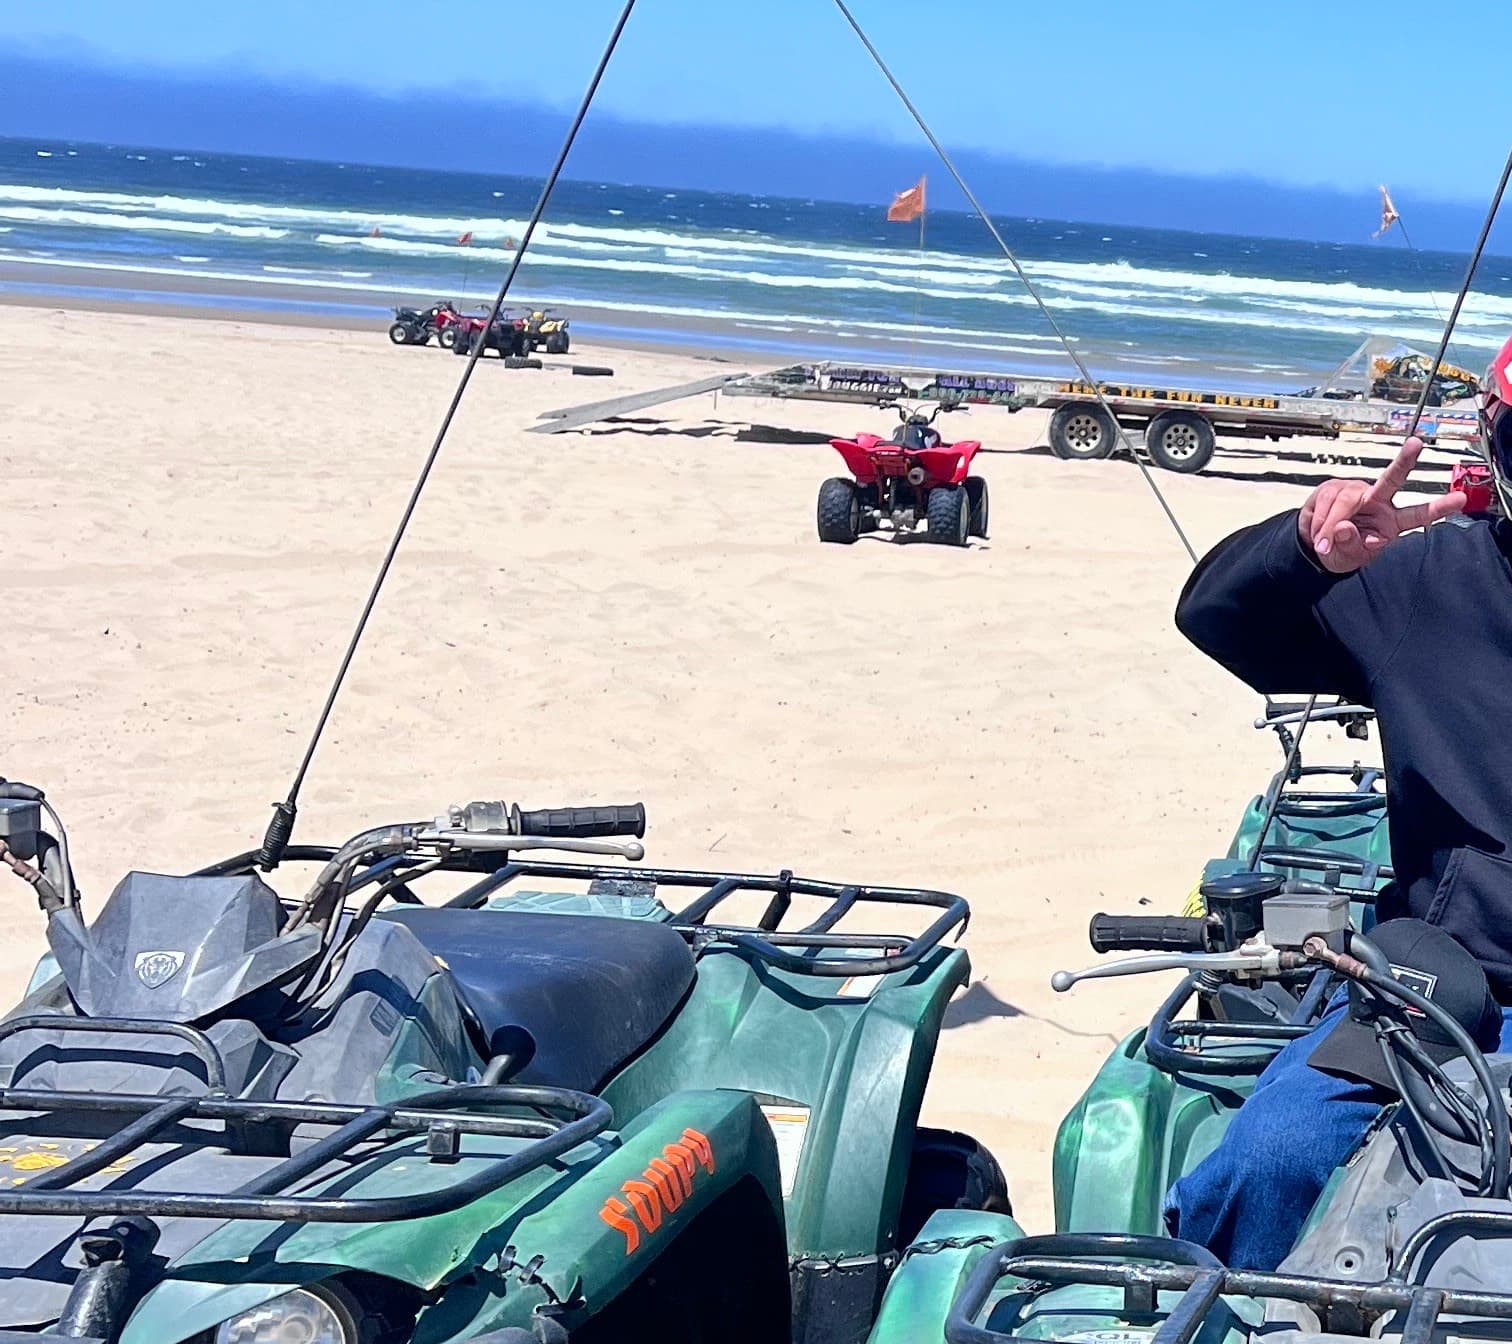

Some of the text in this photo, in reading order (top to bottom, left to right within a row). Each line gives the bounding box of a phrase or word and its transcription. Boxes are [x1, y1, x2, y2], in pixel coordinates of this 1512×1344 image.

[1166, 390, 1202, 403] FUN
[1215, 395, 1275, 409] NEVER
[599, 1127, 715, 1255] SOUPY
